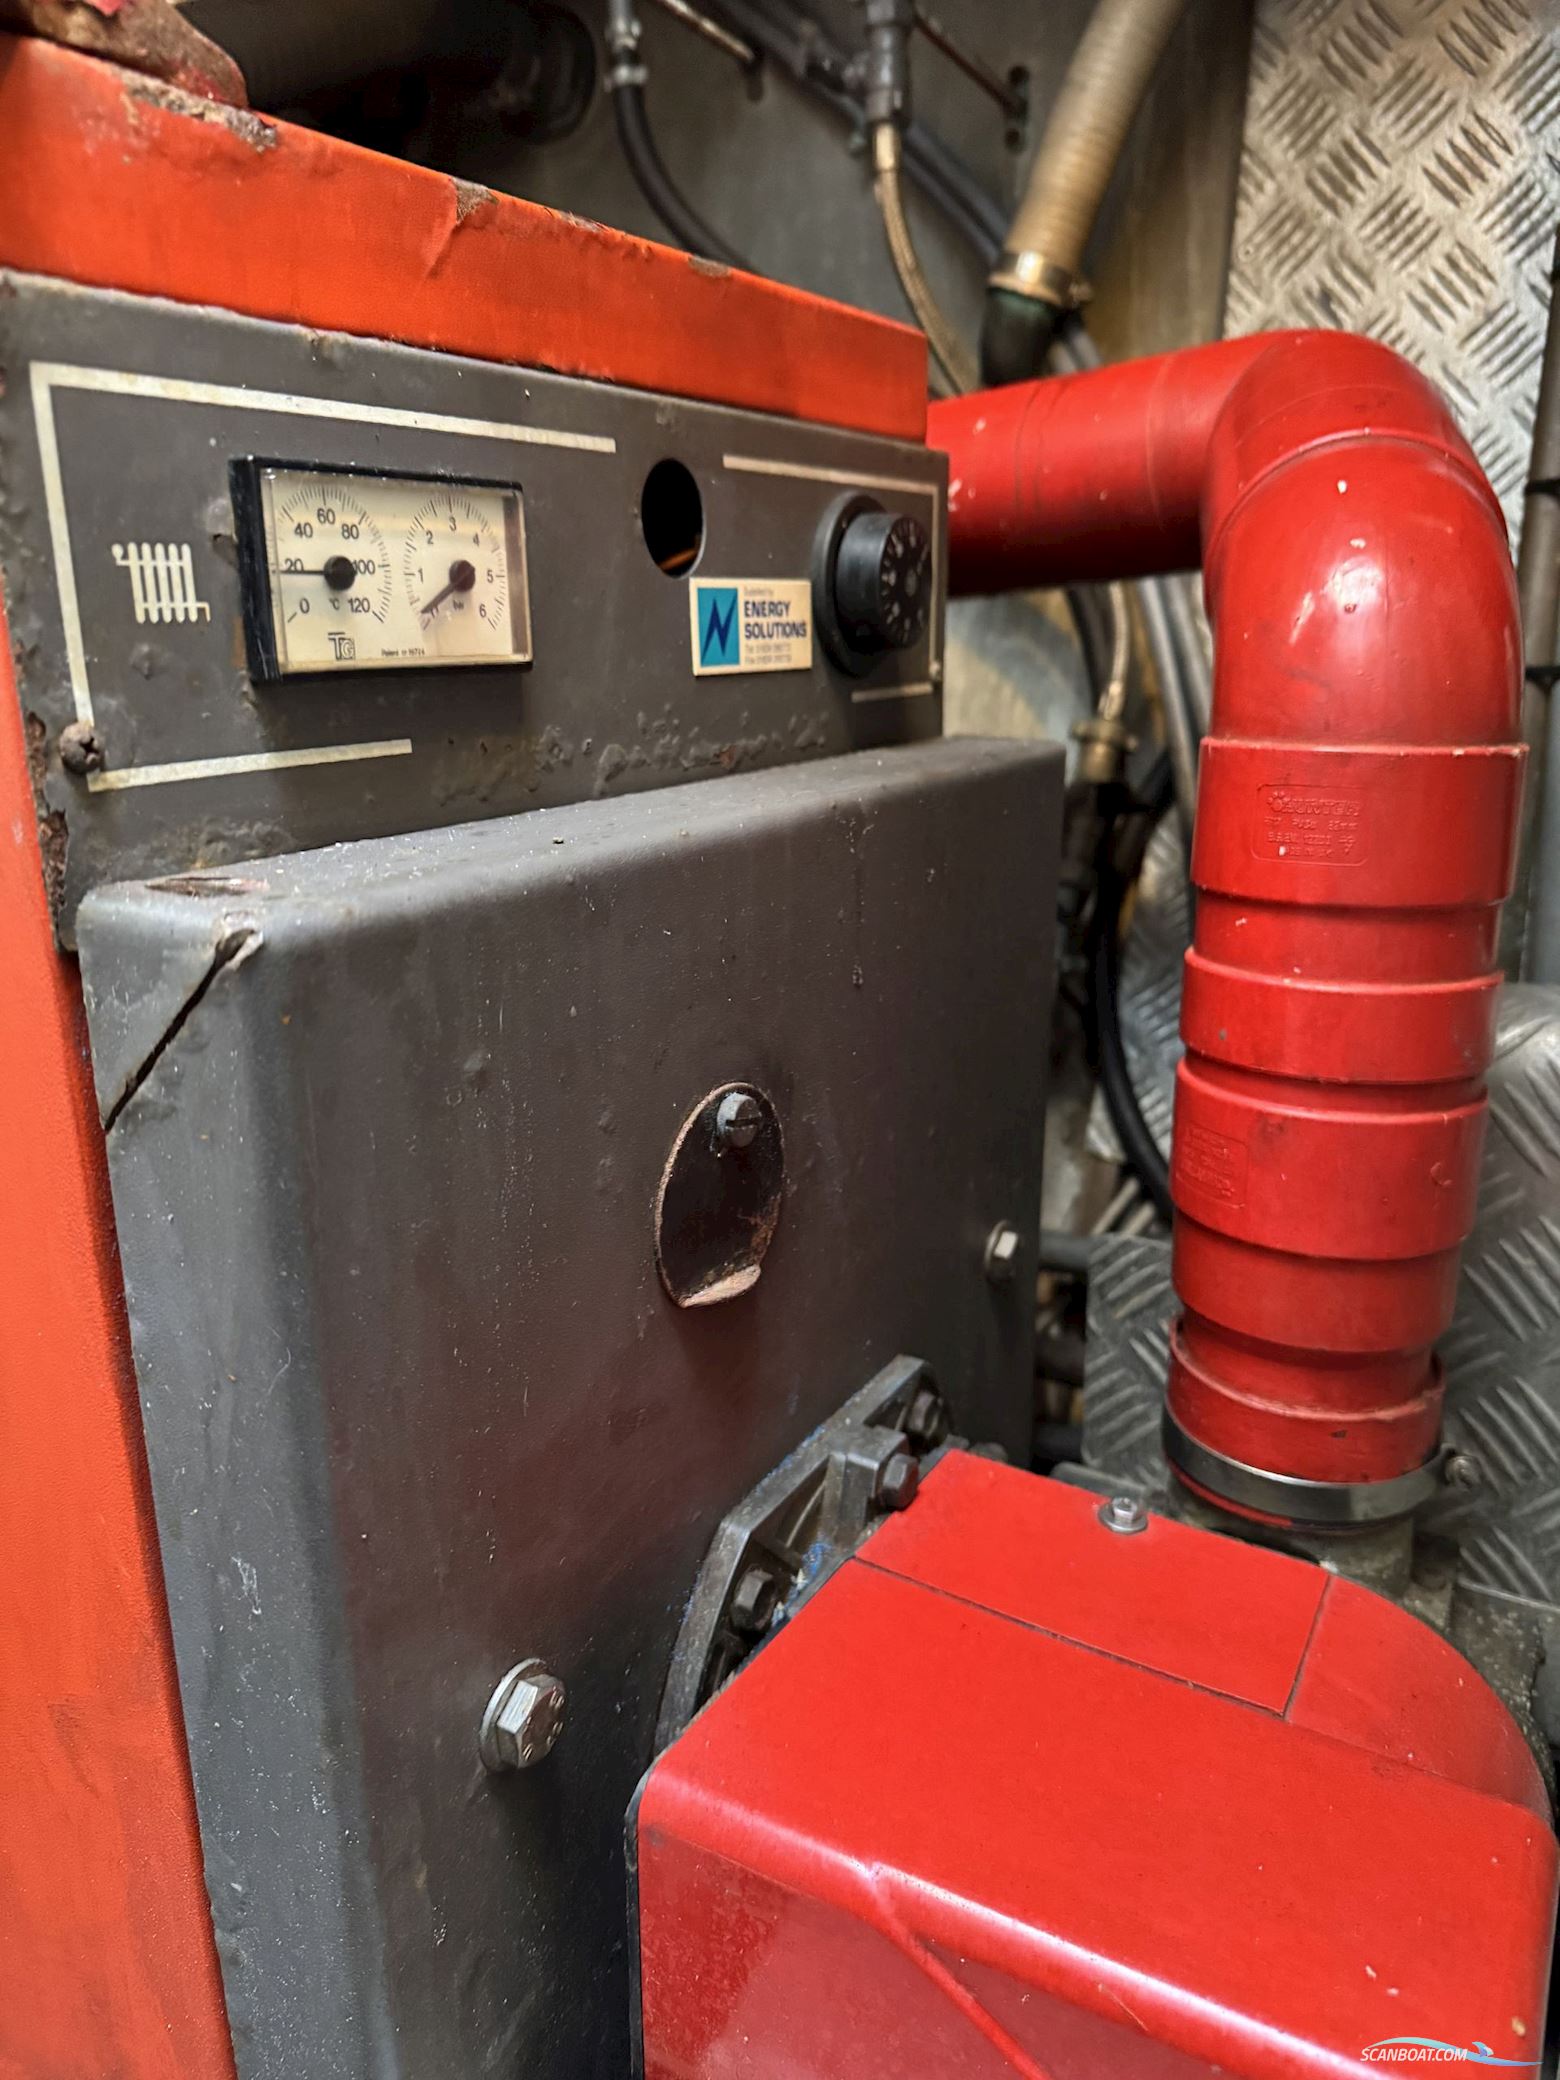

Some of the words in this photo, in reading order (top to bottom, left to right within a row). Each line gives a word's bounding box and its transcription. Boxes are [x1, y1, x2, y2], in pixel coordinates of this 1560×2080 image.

[317, 508, 335, 525] 60
[449, 517, 457, 531] 3
[294, 522, 313, 538] 40
[342, 524, 359, 540] 80
[426, 531, 435, 545] 2
[473, 529, 481, 545] 4
[418, 568, 425, 583] 1
[487, 567, 494, 583] 5
[300, 598, 310, 614] 0
[348, 598, 371, 613] 120
[479, 602, 487, 618] 6
[744, 601, 791, 618] ENERGY
[745, 621, 807, 638] SOLUTIONS
